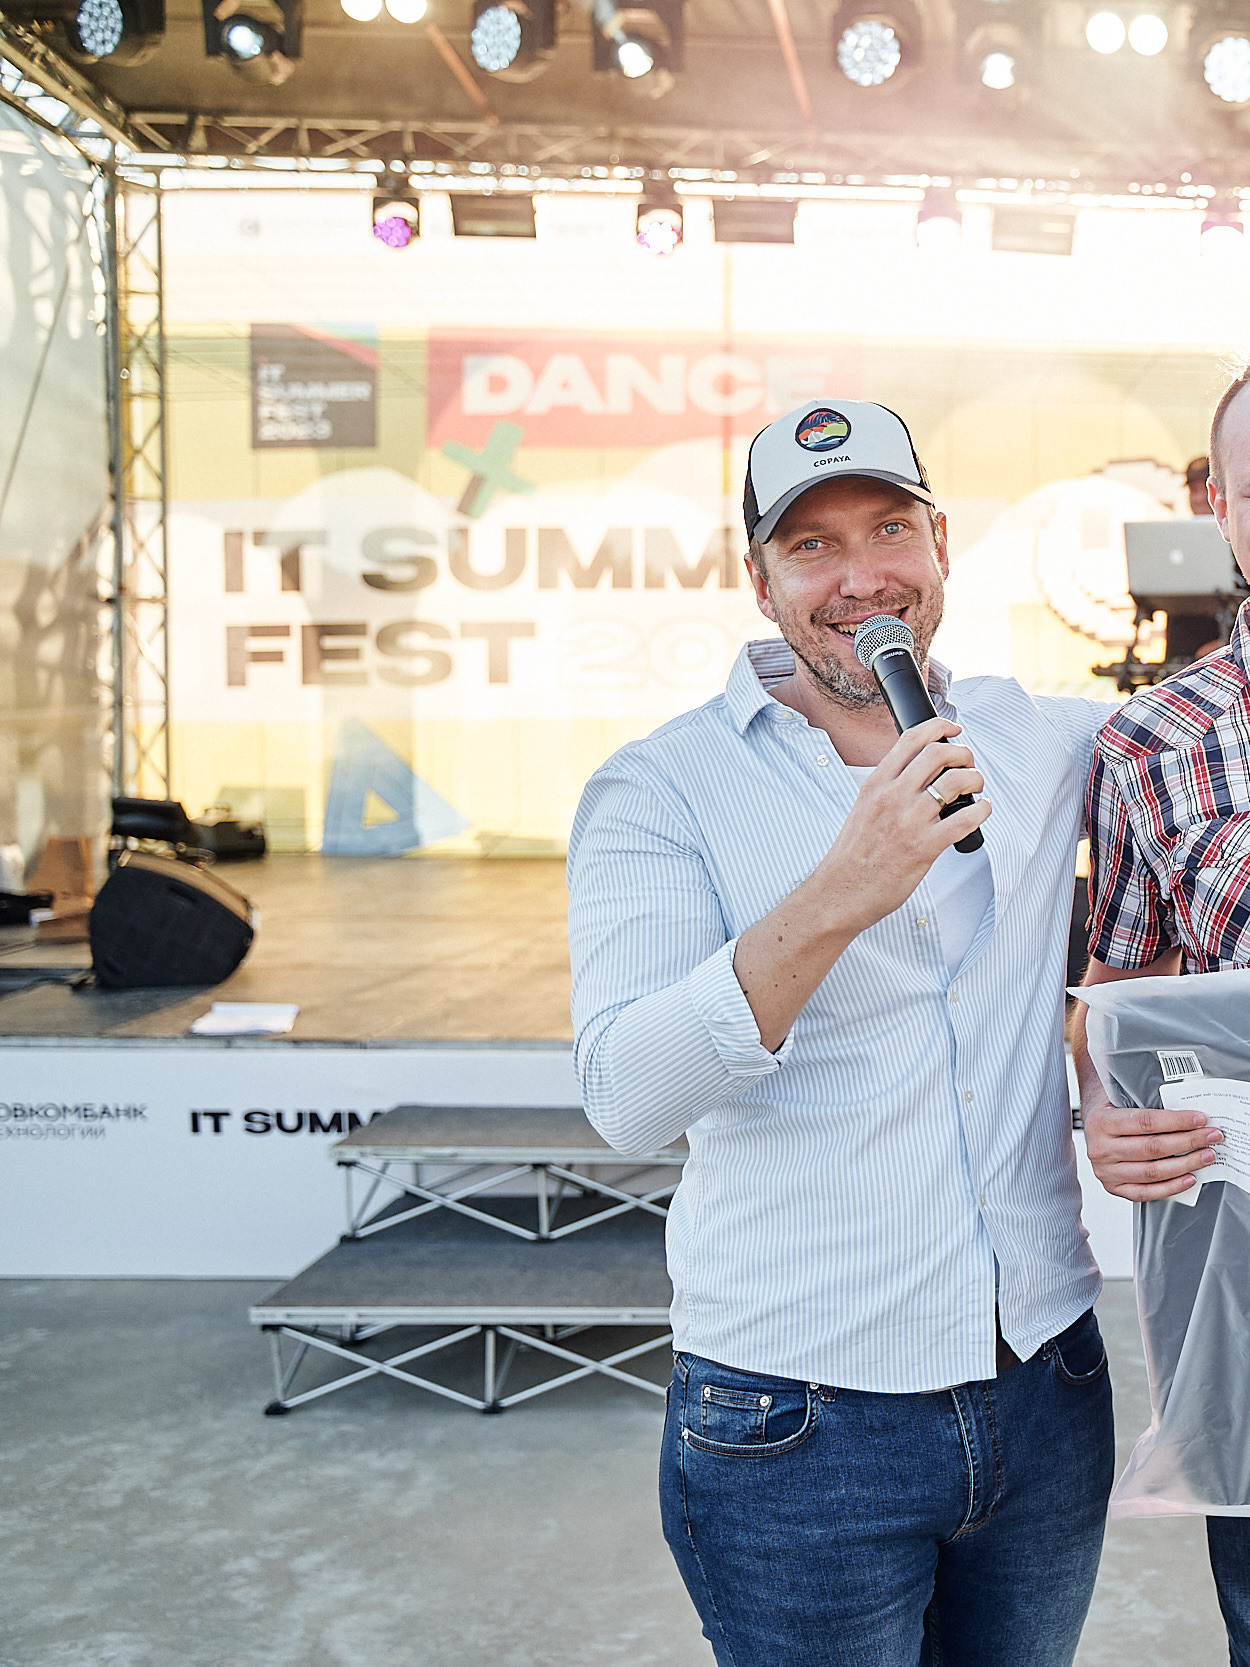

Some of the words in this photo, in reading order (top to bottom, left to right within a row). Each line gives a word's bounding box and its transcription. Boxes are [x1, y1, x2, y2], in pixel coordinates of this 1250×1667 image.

[258, 381, 373, 402] SUMMER
[462, 353, 832, 416] DANCE
[813, 455, 851, 467] COPAYA
[224, 530, 328, 592] IT
[362, 527, 754, 591] SUMM
[226, 621, 535, 687] FEST
[556, 613, 783, 692] 20
[191, 1111, 231, 1133] IT
